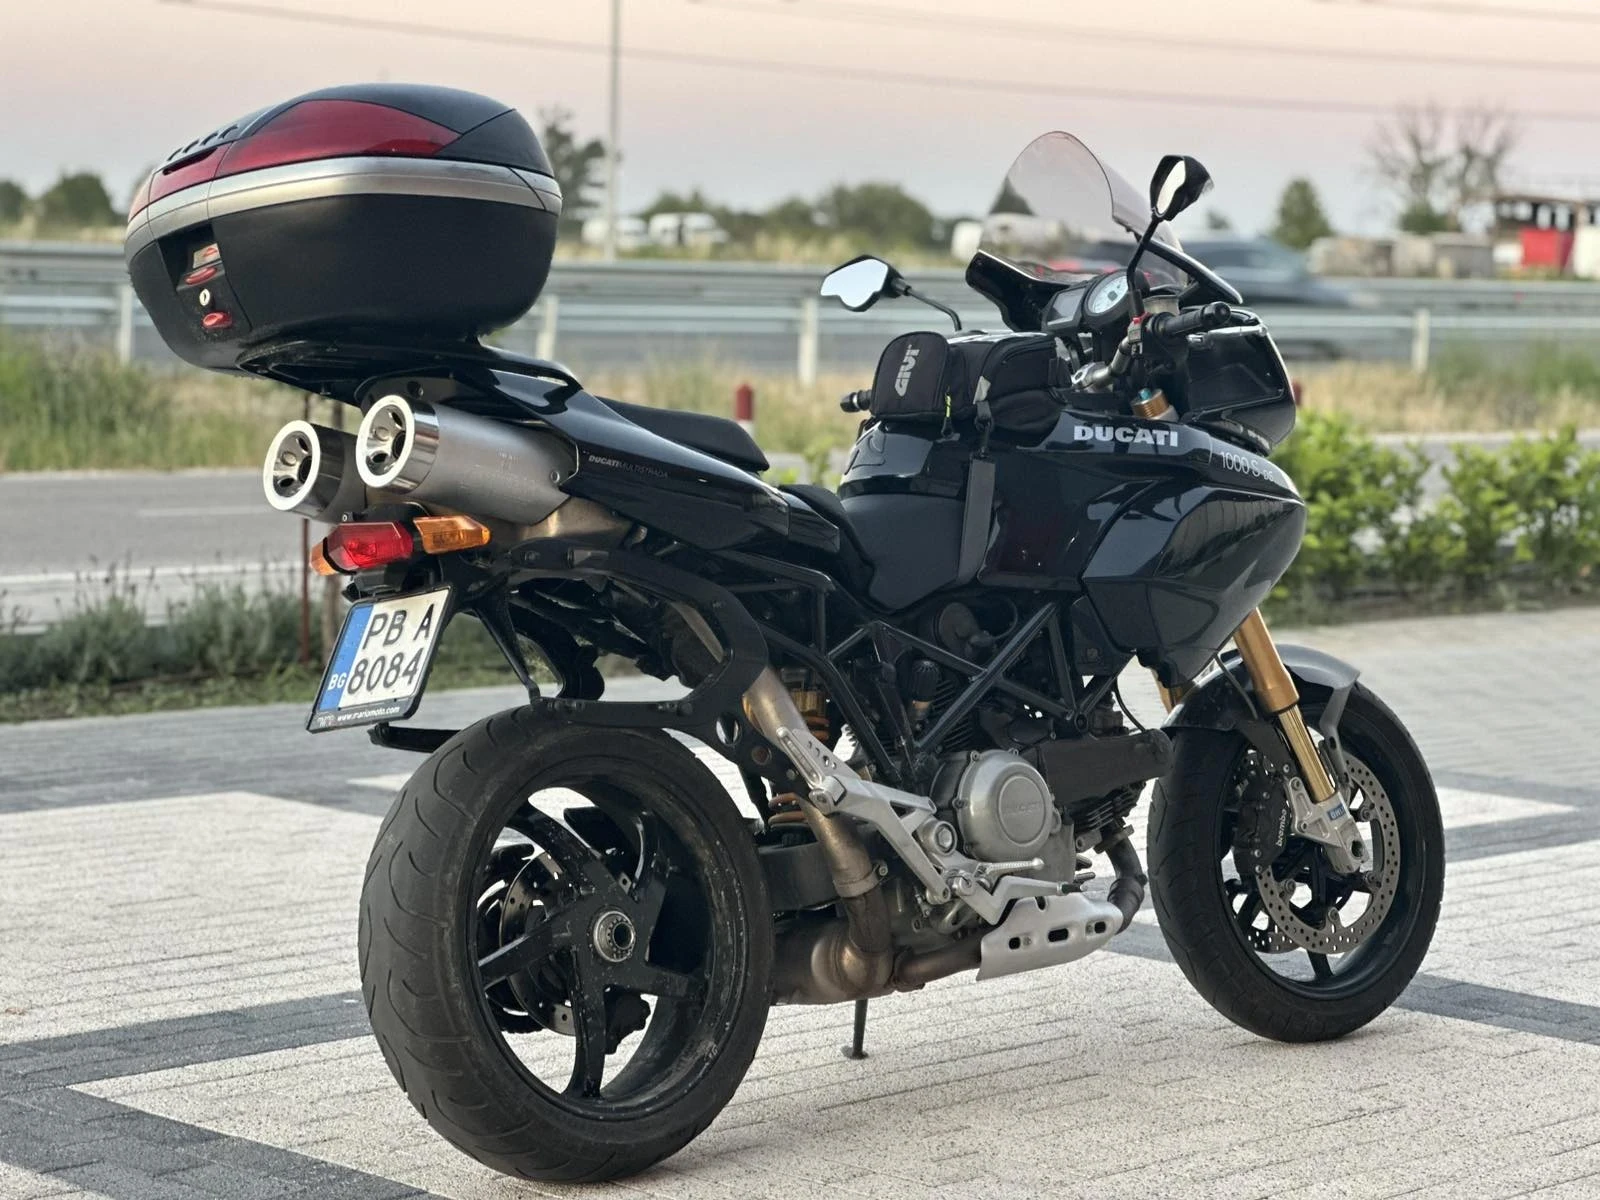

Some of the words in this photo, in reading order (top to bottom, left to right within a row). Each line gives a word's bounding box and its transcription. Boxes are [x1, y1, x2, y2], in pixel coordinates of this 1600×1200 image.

[894, 344, 920, 397] GIVI
[1073, 425, 1179, 447] DUCATI
[362, 609, 407, 650] PB
[413, 603, 435, 642] A
[327, 672, 347, 691] BG
[347, 647, 424, 695] 8084
[1275, 808, 1288, 848] brembo
